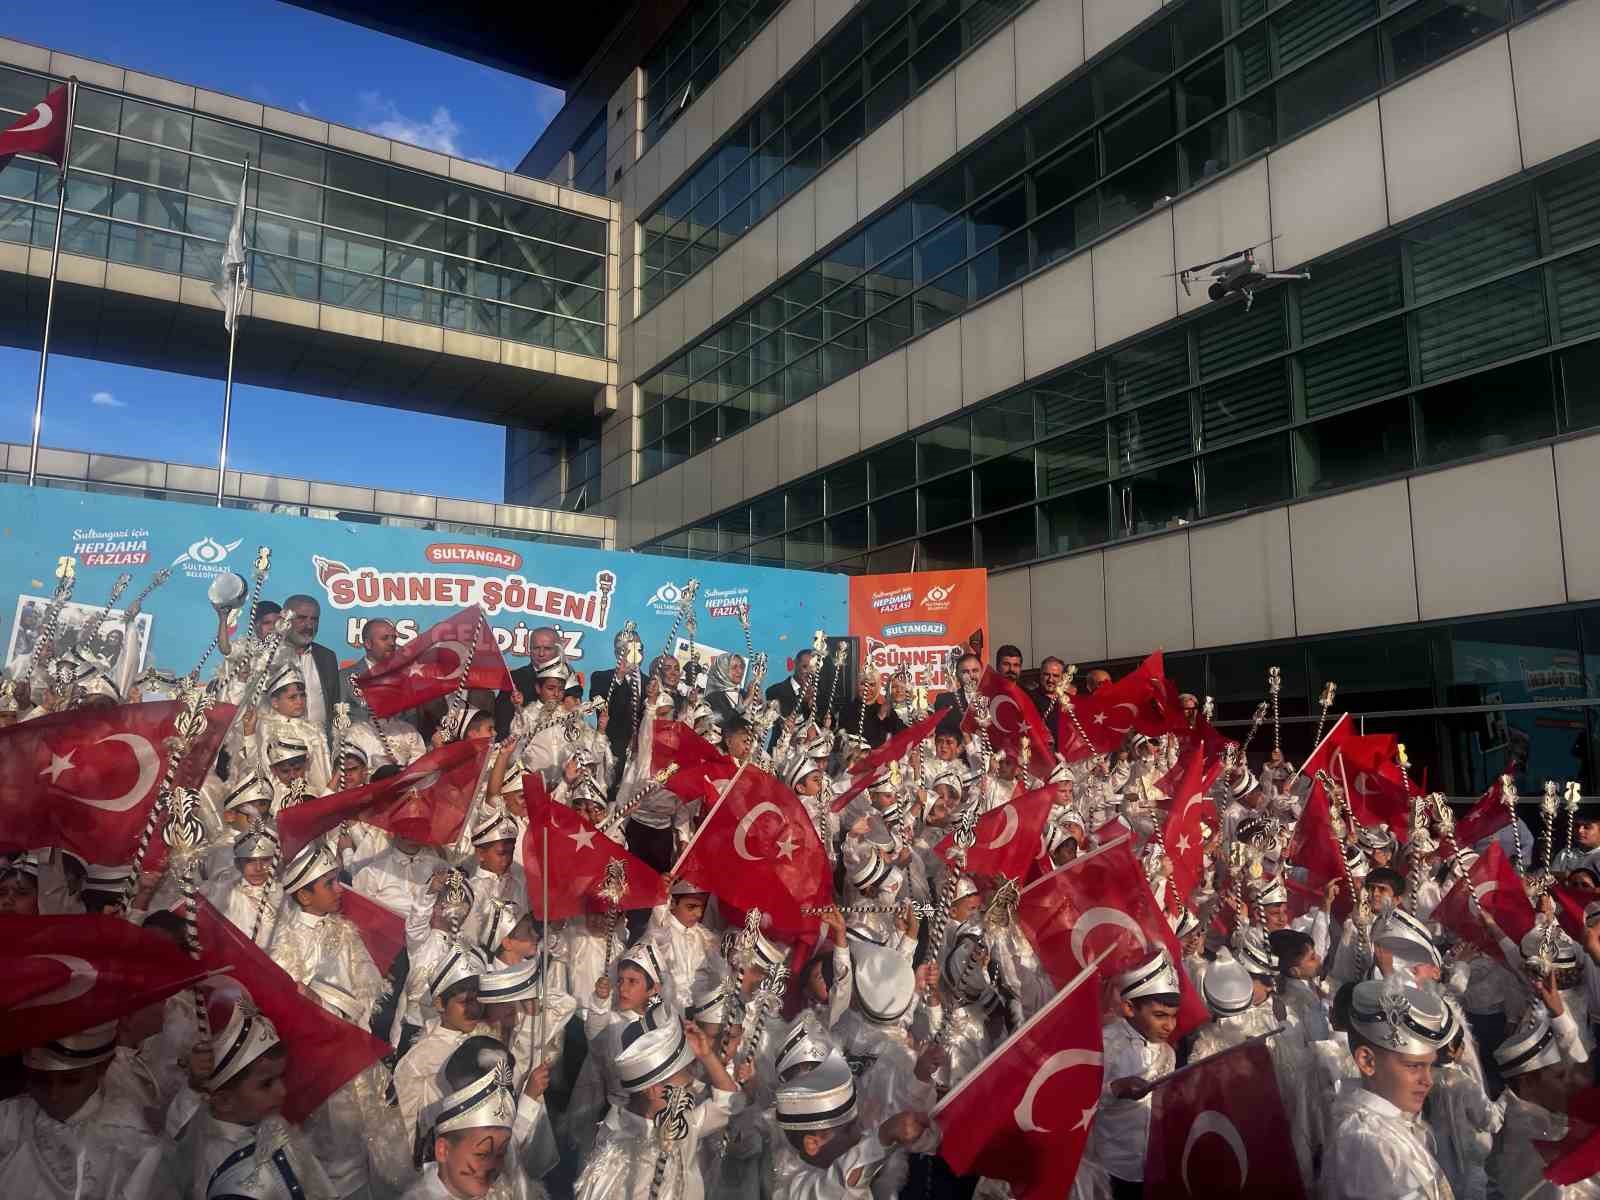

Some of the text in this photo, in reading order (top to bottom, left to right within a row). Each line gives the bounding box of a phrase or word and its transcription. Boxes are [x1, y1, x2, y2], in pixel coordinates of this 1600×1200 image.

[432, 548, 518, 567] SULTANGAZİ
[331, 572, 597, 623] SÜNNET ŞÖLENİ
[875, 648, 946, 668] SÜNNET
